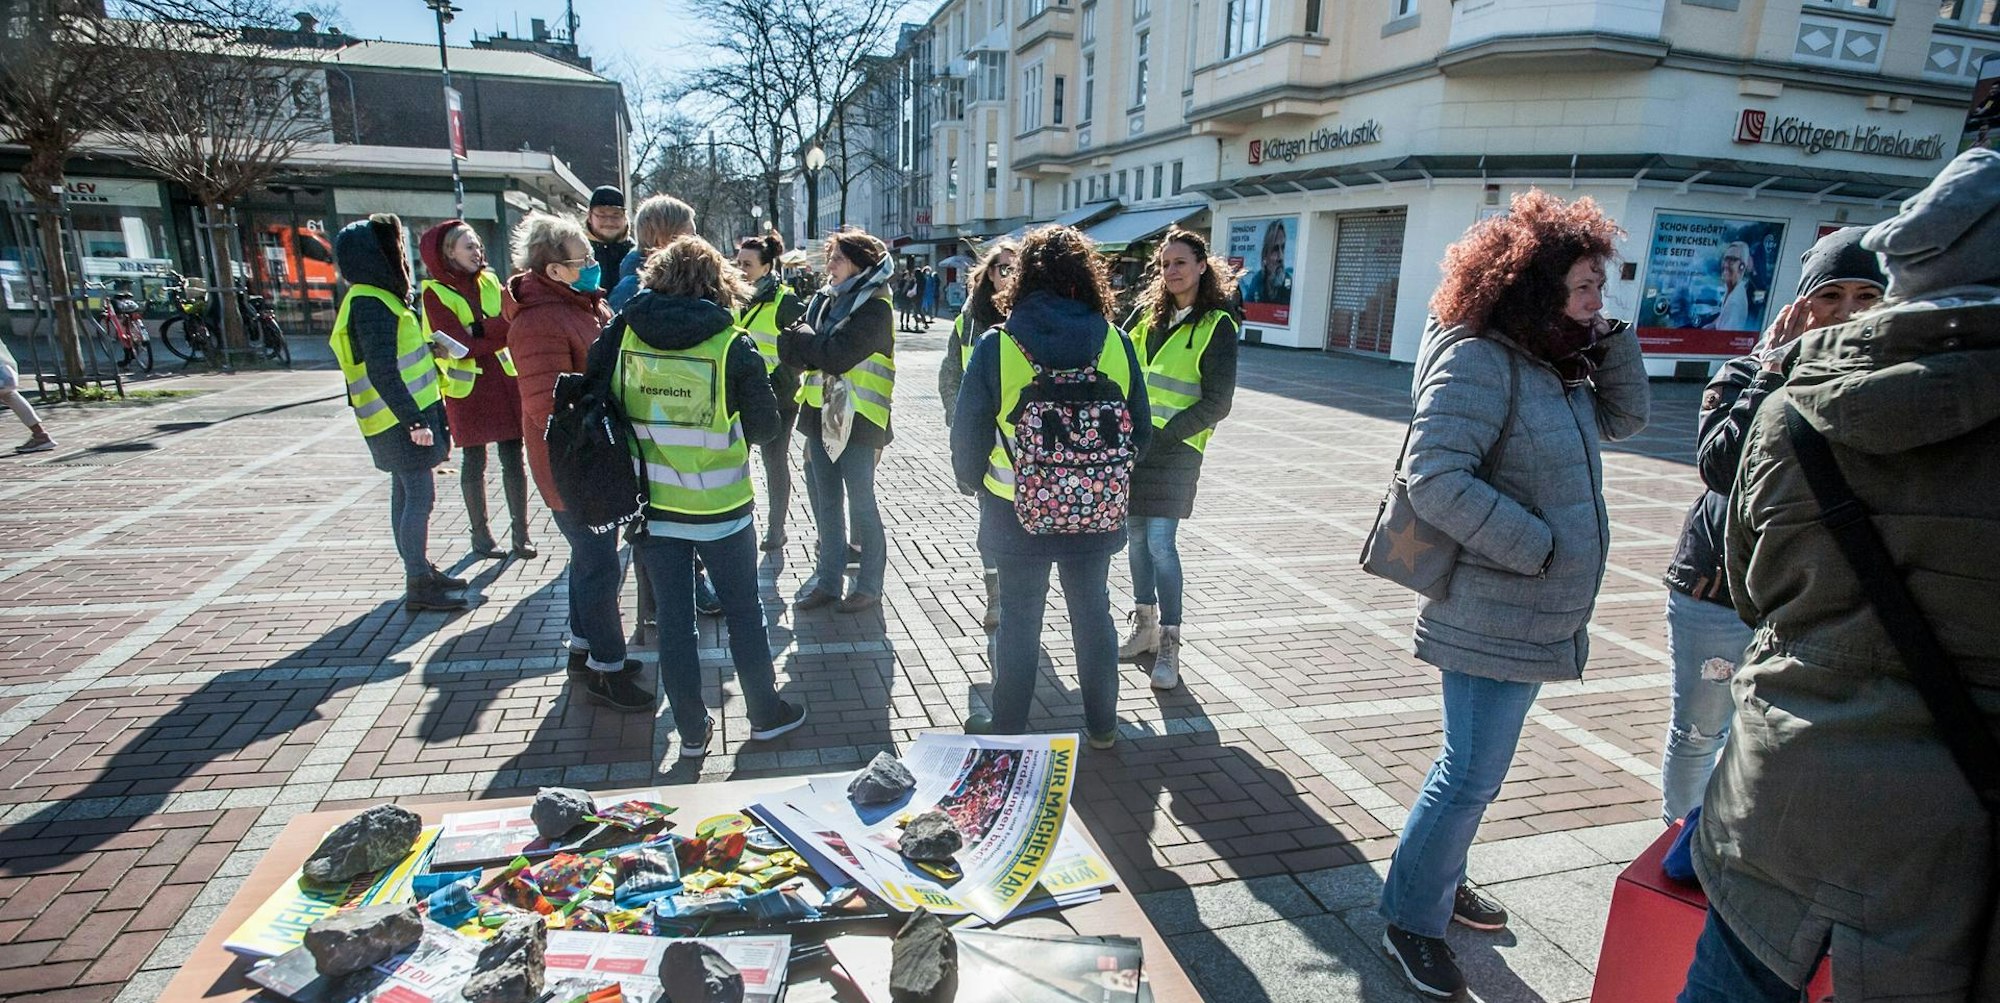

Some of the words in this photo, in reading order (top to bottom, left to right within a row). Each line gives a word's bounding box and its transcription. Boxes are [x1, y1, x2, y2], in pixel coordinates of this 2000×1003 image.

[1264, 138, 1306, 162] Köttgen
[1309, 118, 1379, 152] Hörakustik
[1771, 116, 1848, 154] Köttgen
[1852, 124, 1946, 160] Hörakustik
[306, 219, 325, 232] 61
[1659, 222, 1688, 231] SCHON
[1690, 223, 1728, 234] GEHÖRT?
[1655, 247, 1668, 255] DIE
[1670, 248, 1696, 257] SEITE!
[1658, 235, 1673, 243] WIR
[1675, 236, 1719, 247] WECHSELN
[640, 385, 692, 398] #esreicht
[1051, 749, 1071, 787] WIR
[996, 749, 1034, 831] Forderungen
[1023, 791, 1064, 867] MACHEN
